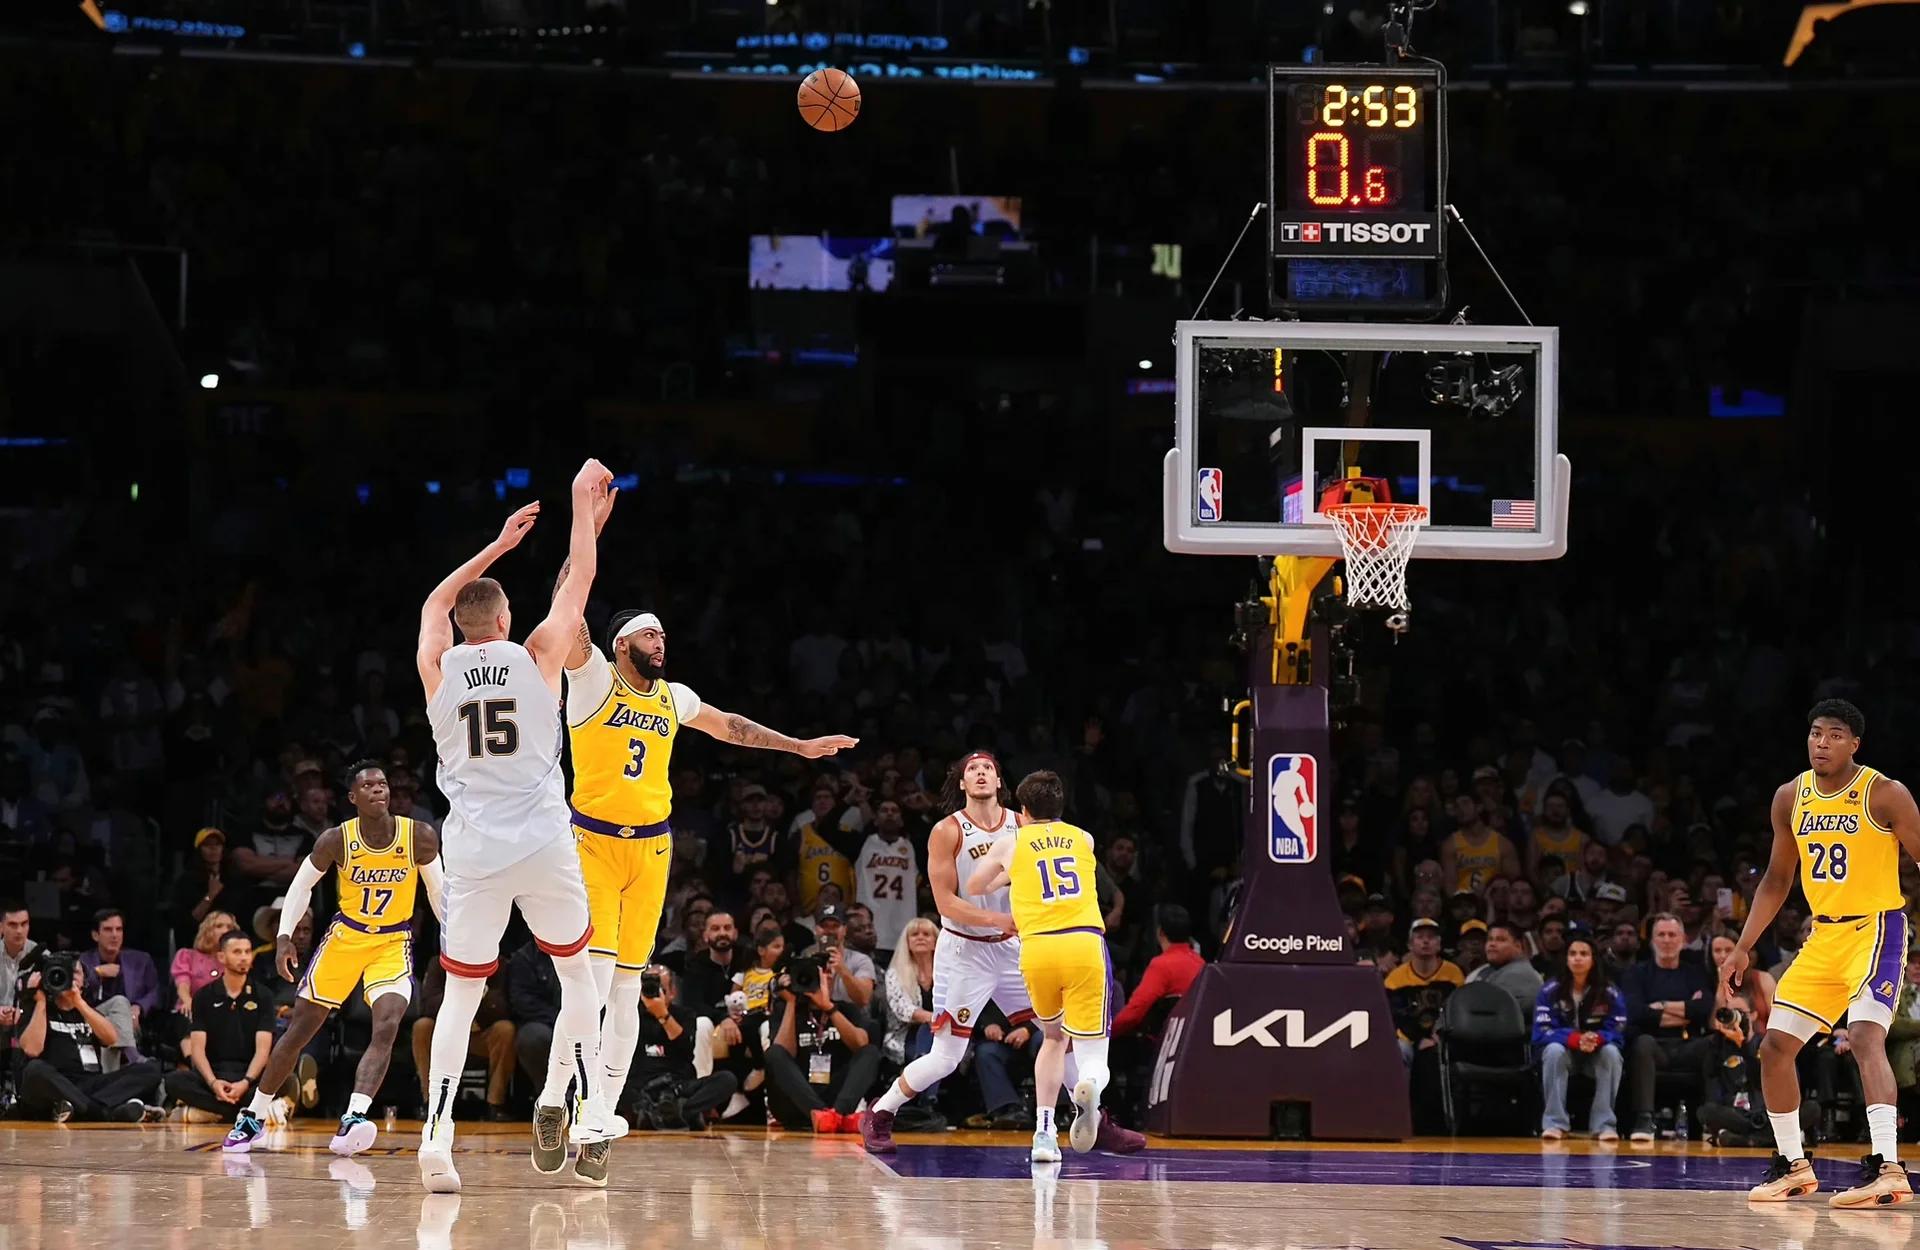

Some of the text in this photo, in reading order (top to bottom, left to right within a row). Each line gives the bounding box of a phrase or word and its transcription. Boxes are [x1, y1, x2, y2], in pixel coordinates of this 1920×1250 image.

[1323, 85, 1416, 128] 2:53
[1307, 132, 1386, 205] 0.6
[1322, 222, 1431, 243] TISSOT
[463, 665, 510, 690] JOKIĆ
[457, 698, 521, 759] 15
[603, 702, 671, 738] LAKERS
[624, 738, 647, 778] 3
[1796, 810, 1859, 835] LAKERS
[1030, 835, 1074, 852] REAVES
[1275, 836, 1300, 856] NBA
[350, 865, 408, 884] LAKERS
[818, 862, 830, 882] 6
[866, 852, 910, 871] LAKERS
[1807, 843, 1849, 881] 28
[873, 874, 904, 900] 24
[1036, 856, 1081, 901] 15
[359, 887, 394, 917] 17
[1244, 933, 1343, 955] Google Pixel
[1212, 1008, 1370, 1049] KIA
